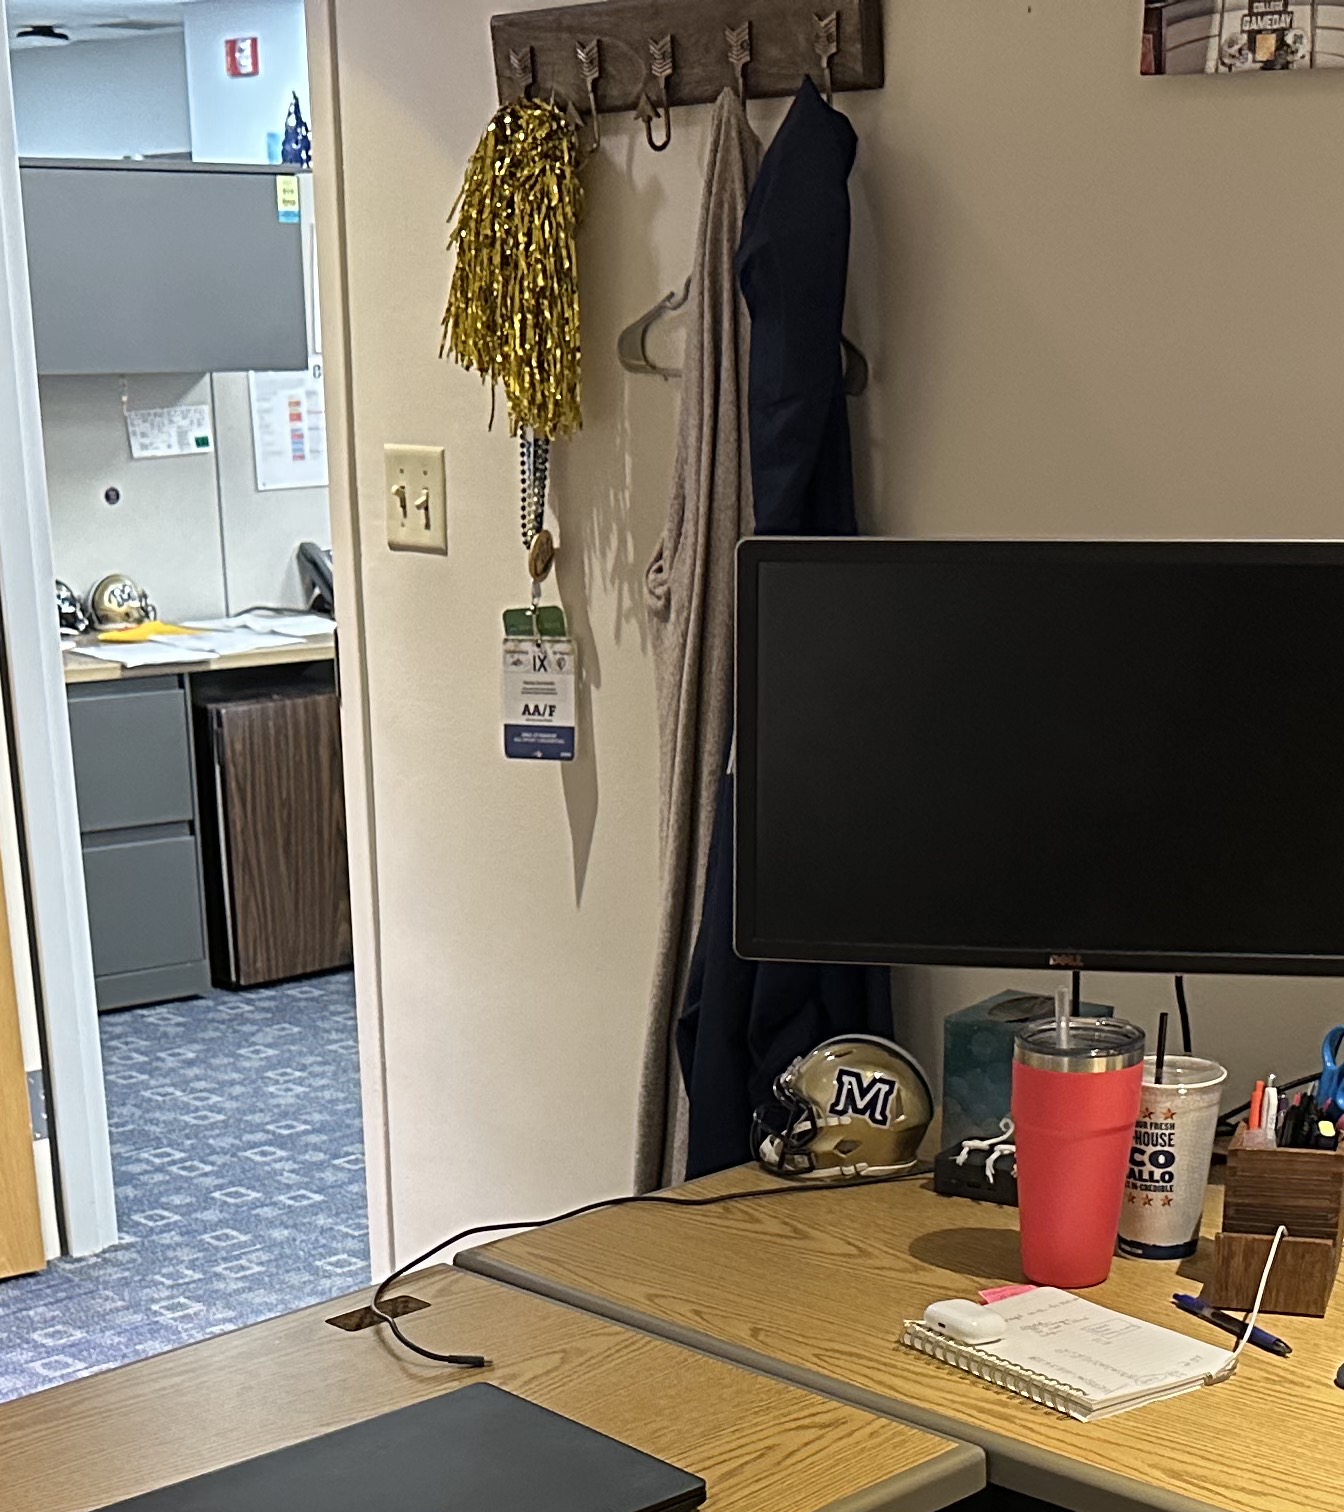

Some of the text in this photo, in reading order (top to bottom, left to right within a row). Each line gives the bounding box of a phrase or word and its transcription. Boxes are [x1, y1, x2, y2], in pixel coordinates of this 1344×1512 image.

[1242, 13, 1292, 30] GAMEDAY
[532, 655, 548, 672] IX
[521, 703, 557, 718] AA/F
[829, 1067, 896, 1127] M
[1150, 1122, 1175, 1131] FRESH
[1128, 1147, 1176, 1169] CO
[1126, 1168, 1174, 1184] ALLO
[1132, 1183, 1174, 1193] IN-CREDIBLE
